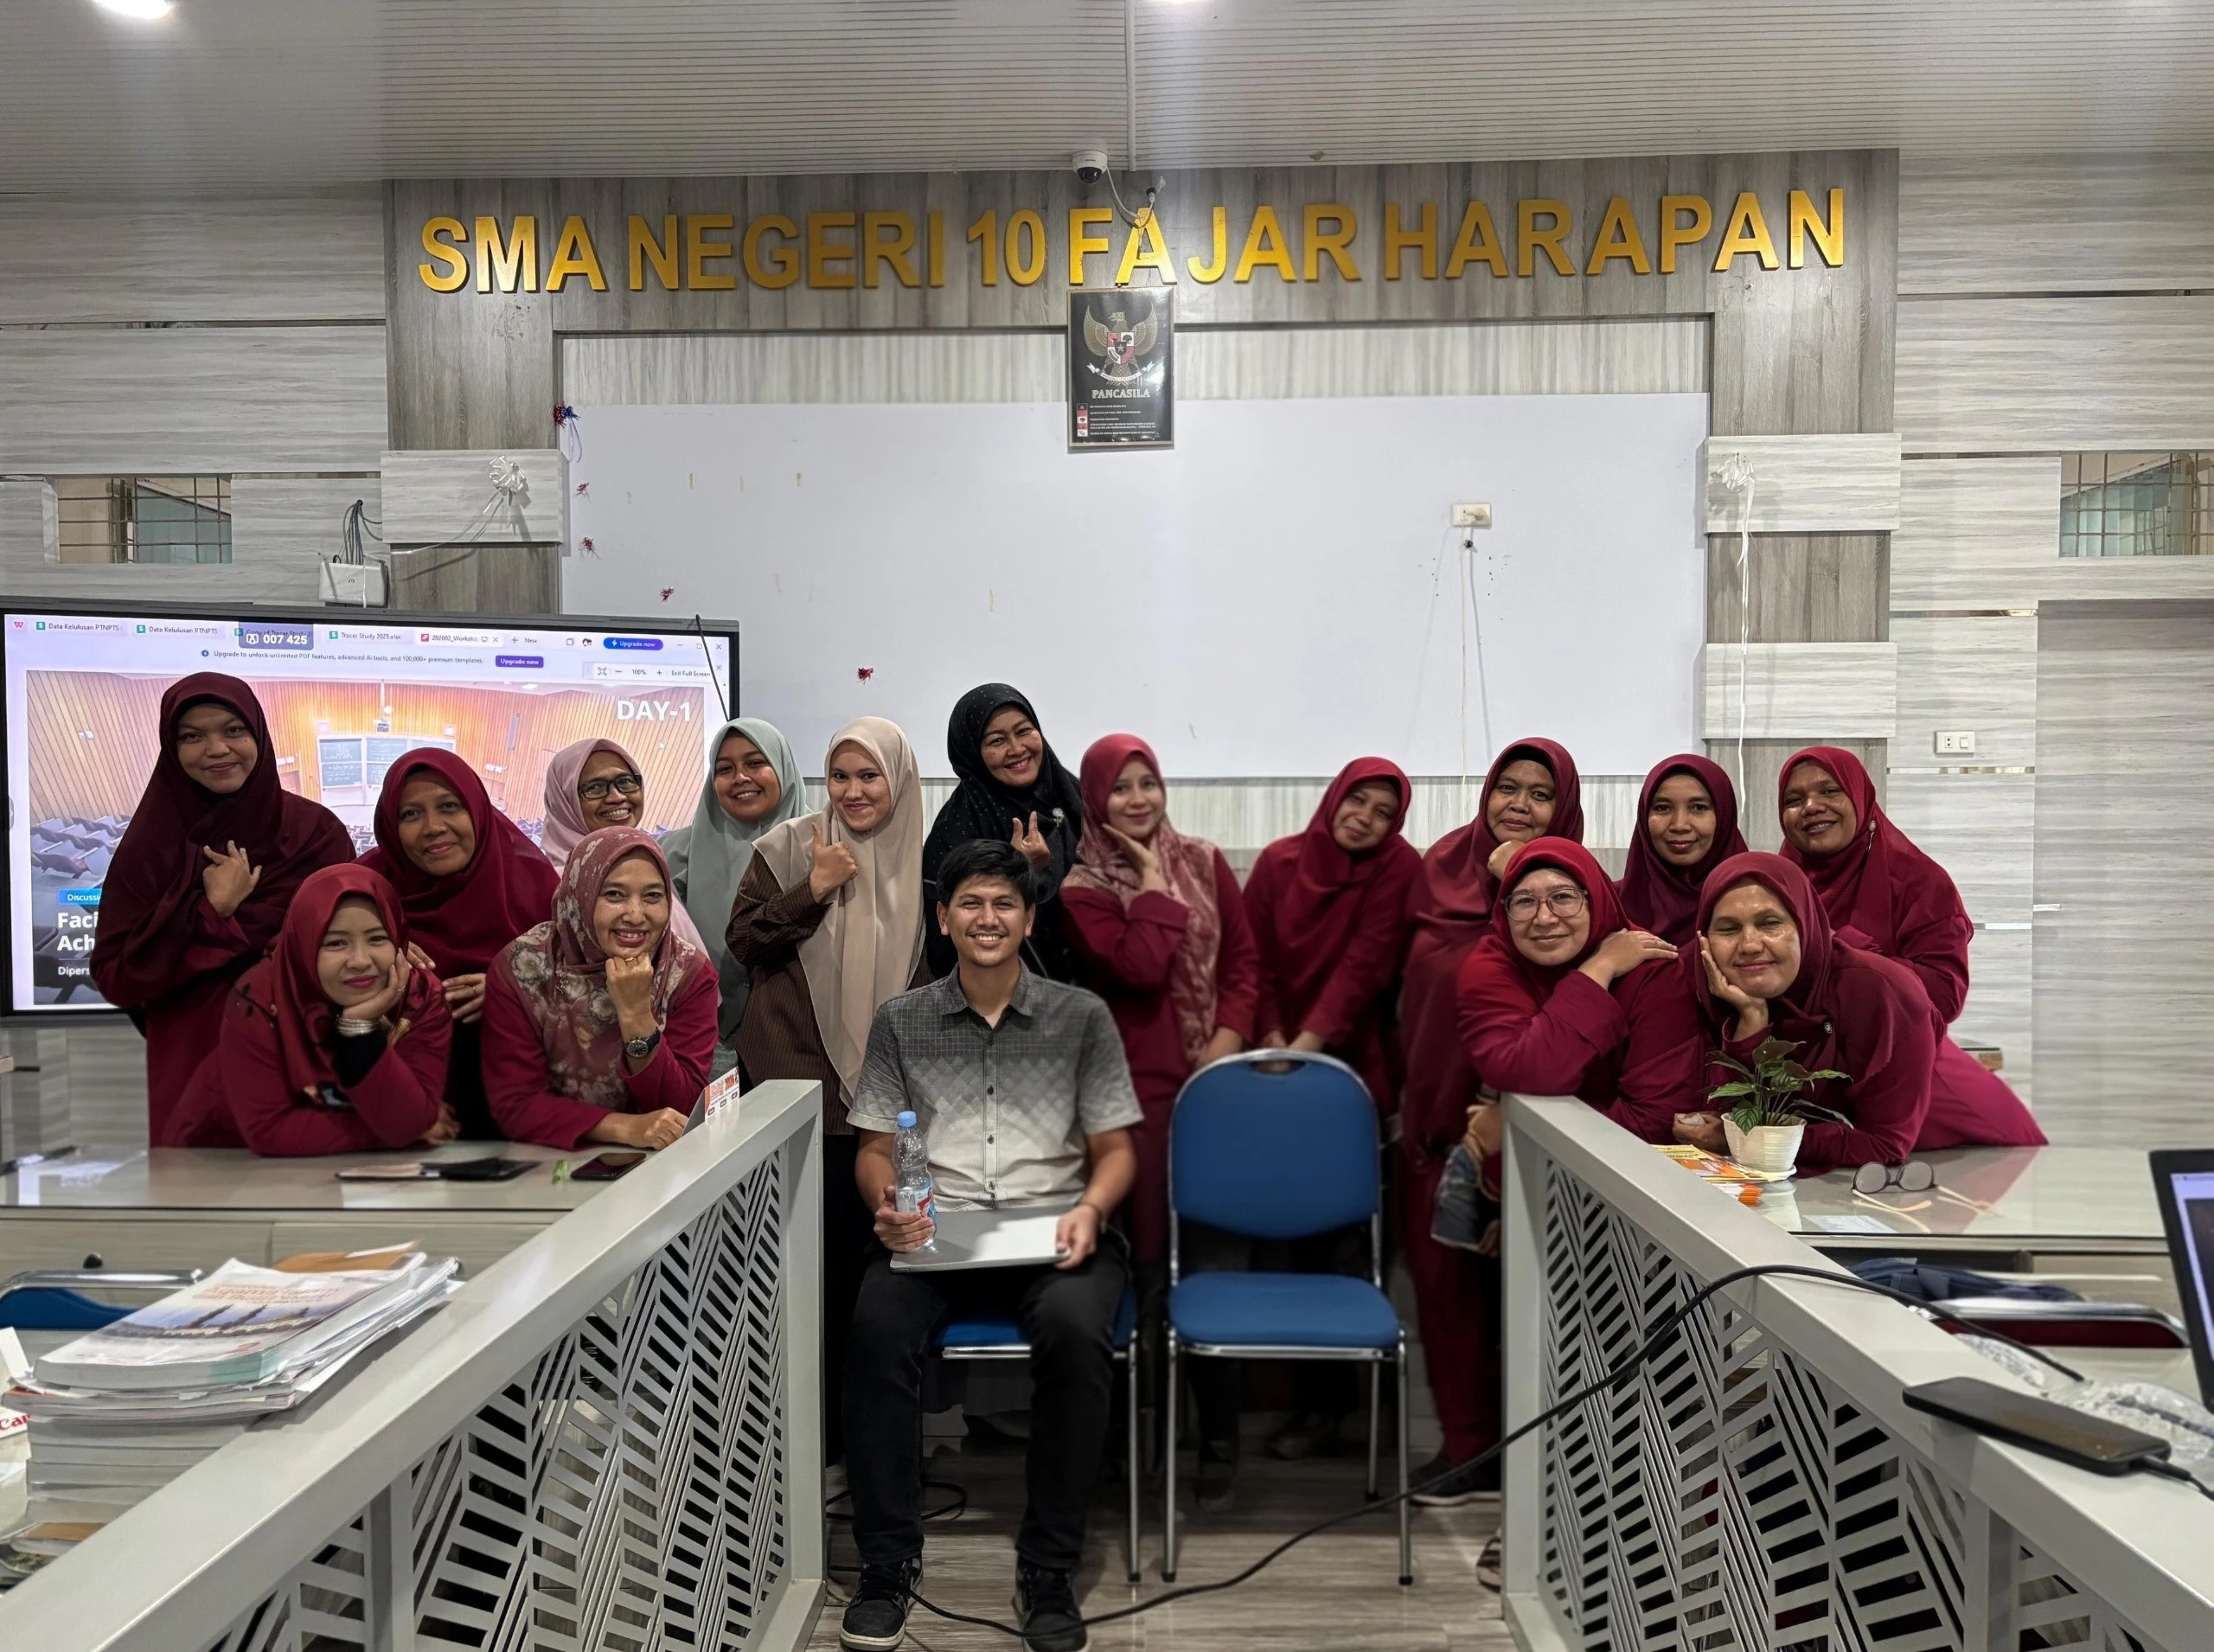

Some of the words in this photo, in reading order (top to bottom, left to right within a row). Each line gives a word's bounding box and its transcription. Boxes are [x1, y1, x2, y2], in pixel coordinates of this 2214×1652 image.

[419, 215, 607, 292] SMA
[628, 210, 944, 291] NEGERI
[967, 208, 1046, 287] 10
[1070, 204, 1362, 285] FAJAR
[1385, 189, 1844, 279] HARAPAN
[1091, 388, 1150, 399] PANCASILA
[263, 634, 284, 644] 007
[286, 635, 308, 644] 425
[619, 639, 643, 648] Upgrade
[617, 700, 690, 722] DAY-1
[58, 912, 99, 928] Faci
[56, 933, 95, 951] Ach
